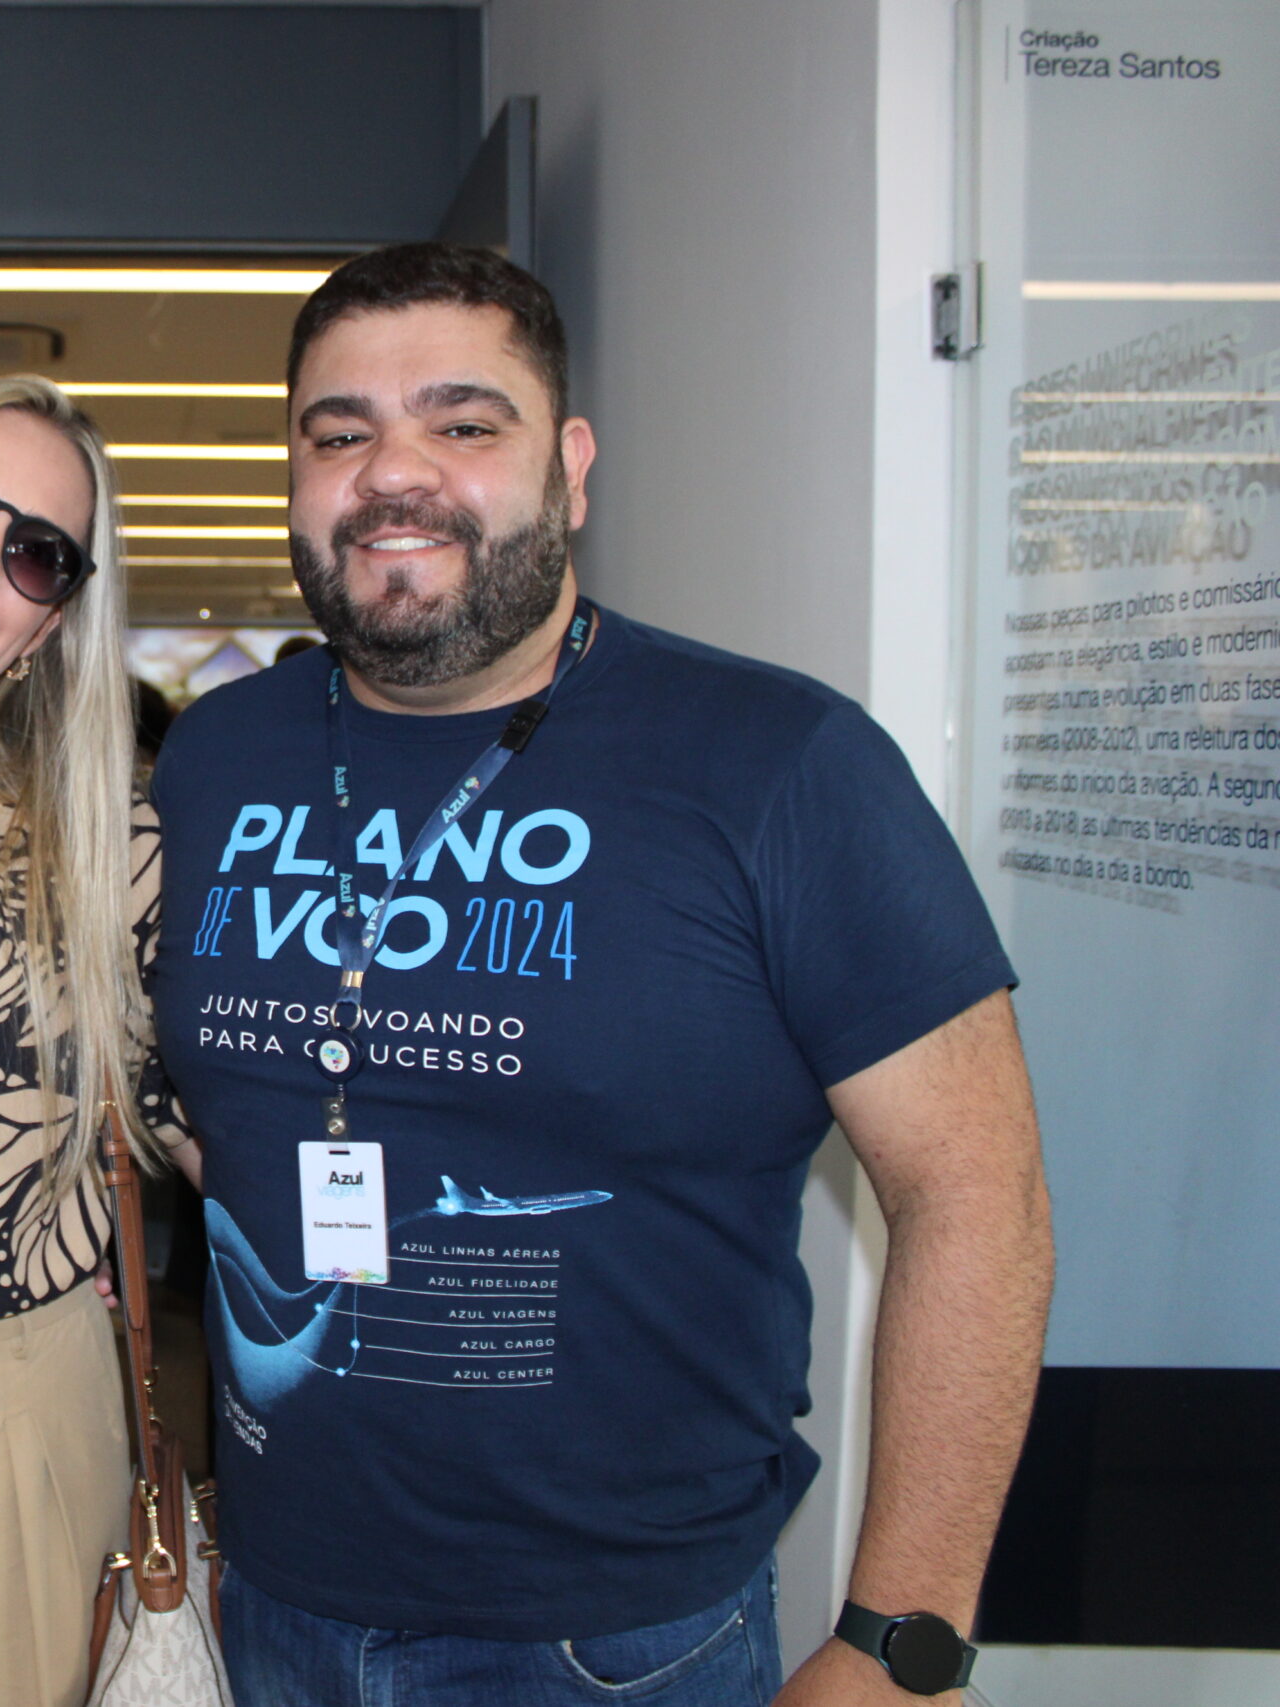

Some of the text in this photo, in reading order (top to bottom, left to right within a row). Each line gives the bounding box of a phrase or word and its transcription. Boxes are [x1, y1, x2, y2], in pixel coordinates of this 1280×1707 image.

[1020, 30, 1099, 51] Criação
[1020, 51, 1221, 79] Tereza Santos
[1092, 600, 1122, 625] para
[1126, 592, 1175, 621] pilotos
[1179, 590, 1189, 611] e
[1148, 631, 1188, 660] estilo
[1192, 633, 1202, 656] e
[1206, 620, 1280, 655] moderni
[1103, 679, 1167, 713] evolução
[1170, 682, 1196, 702] em
[1199, 675, 1240, 702] duas
[1146, 731, 1179, 751] uma
[1184, 723, 1248, 751] releitura
[1254, 722, 1280, 750] do
[334, 766, 348, 795] Azul
[1119, 770, 1137, 795] da
[1140, 770, 1202, 803] aviação.
[1207, 771, 1220, 798] A
[441, 789, 471, 824] Azul
[218, 804, 591, 885] PLANO
[1082, 817, 1097, 836] as
[1154, 817, 1241, 848] tendências
[1246, 822, 1269, 850] da
[1073, 852, 1093, 878] dia
[1096, 859, 1105, 879] a
[1108, 858, 1128, 882] dia
[1132, 863, 1142, 884] a
[1146, 861, 1195, 890] bordo.
[339, 873, 354, 903] Azul
[193, 887, 242, 956] DE
[456, 897, 577, 980] 2024
[363, 1008, 524, 1039] VOANDO
[200, 1028, 284, 1055] PARA
[370, 1044, 522, 1076] UCESSO
[328, 1170, 363, 1185] Azul
[314, 1221, 372, 1230] Eduardo Teixeira
[401, 1243, 561, 1259] AZUL LINHAS AÉREAS
[428, 1277, 559, 1289] AZUL FIDELIDADE
[449, 1310, 557, 1319] AZUL VIAGENS
[460, 1338, 555, 1350] AZUL CARGO
[453, 1368, 554, 1379] AZUL CENTER
